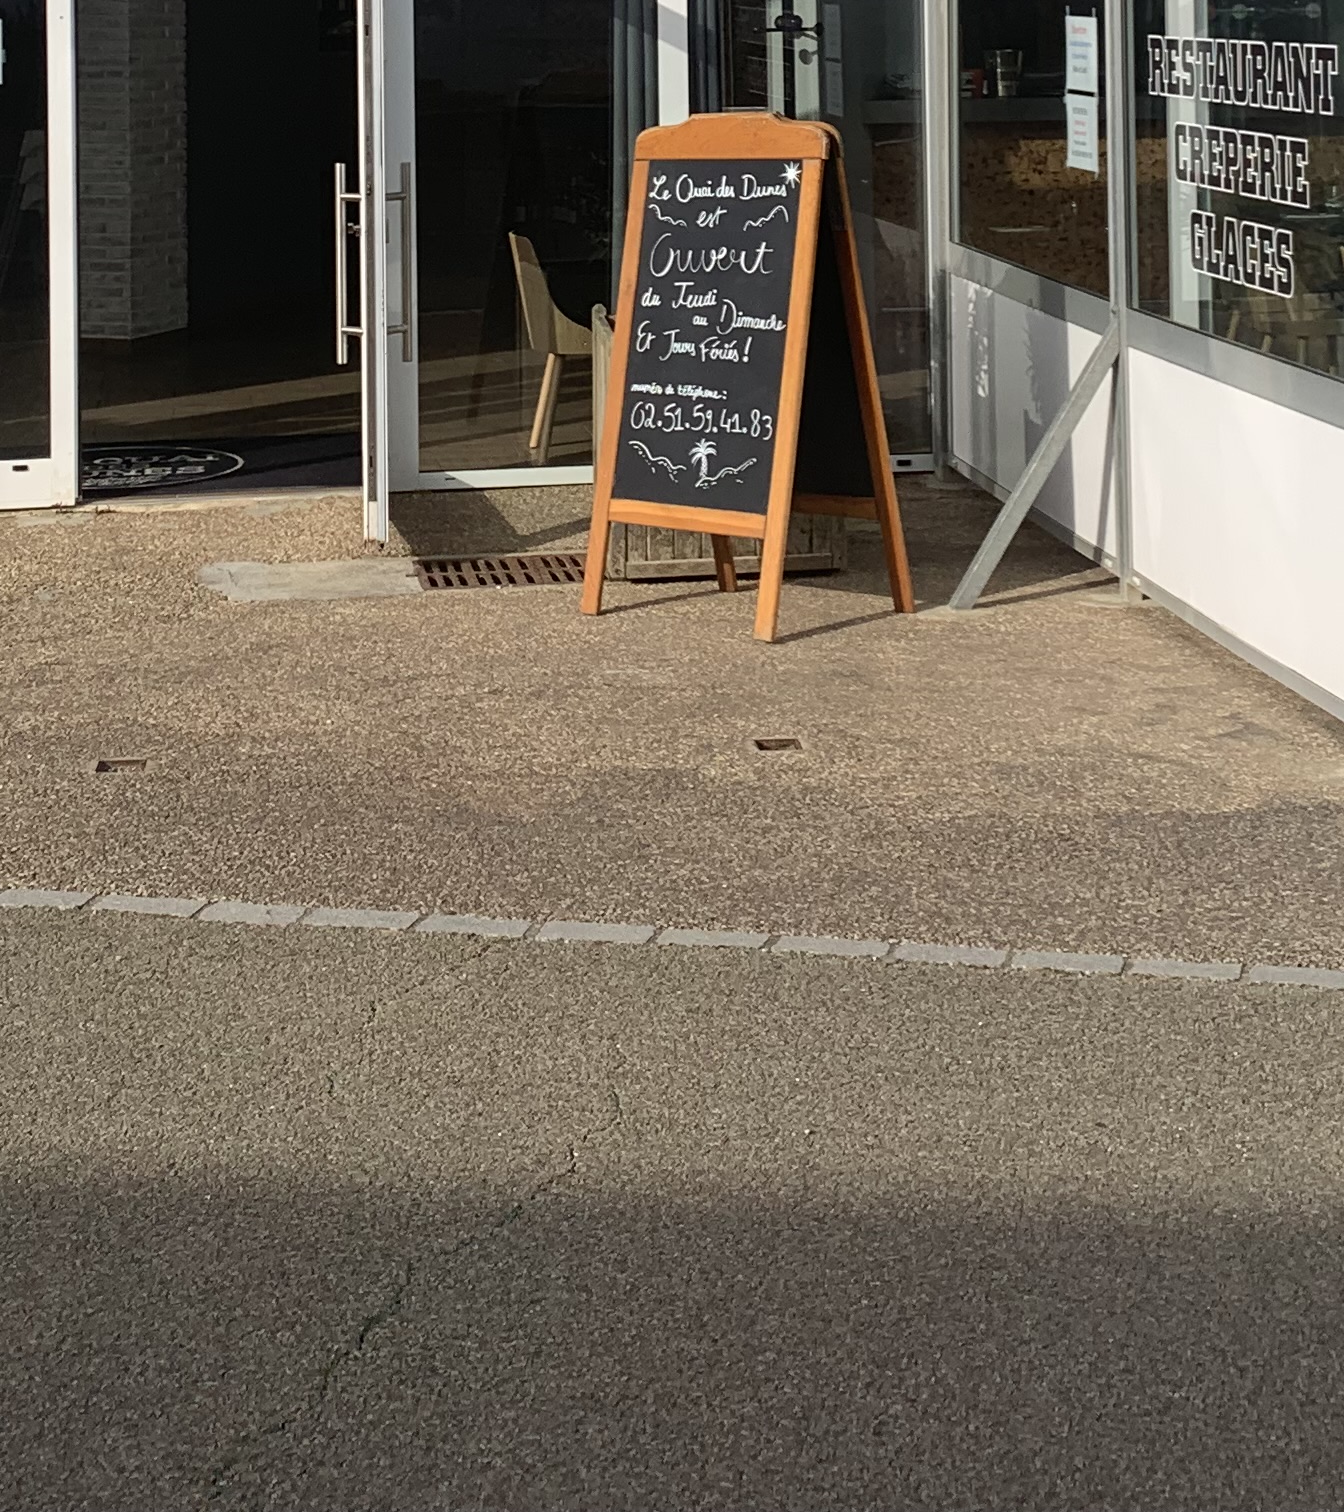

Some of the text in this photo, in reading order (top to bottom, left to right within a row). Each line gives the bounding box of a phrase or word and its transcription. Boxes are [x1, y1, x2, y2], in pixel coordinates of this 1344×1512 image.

[1147, 34, 1339, 116] RESTAURANT
[1174, 121, 1311, 209] CREPERIE
[648, 174, 787, 203] Le Quai des Dunes
[695, 206, 728, 228] est
[649, 232, 774, 278] Ouvert
[1190, 208, 1295, 299] GLACES
[641, 281, 718, 309] du Jeudi
[692, 299, 786, 335] au Dimanche
[636, 320, 656, 353] Et
[659, 329, 697, 361] Jours
[630, 400, 774, 441] 02.51.59.41.83
